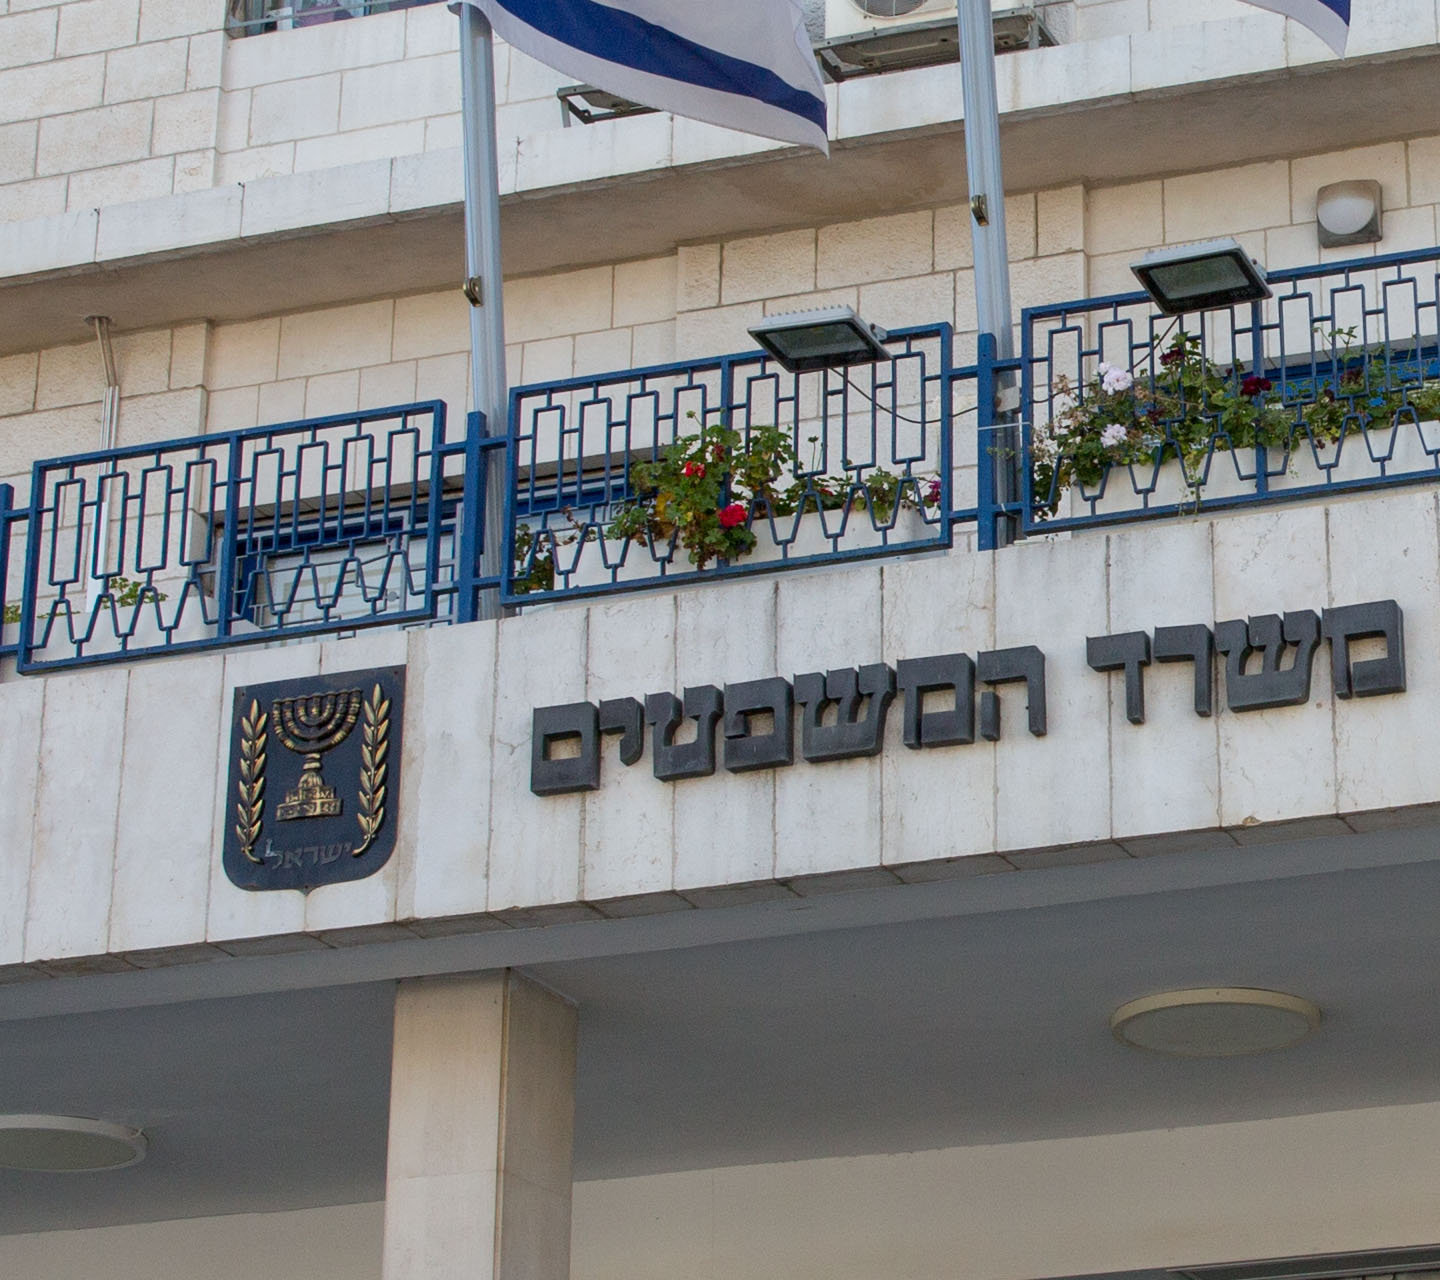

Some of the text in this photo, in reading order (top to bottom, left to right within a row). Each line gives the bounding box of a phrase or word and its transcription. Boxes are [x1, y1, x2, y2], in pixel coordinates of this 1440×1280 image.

[529, 599, 1408, 797] משרד המשפטים
[264, 838, 354, 870] ישראל
